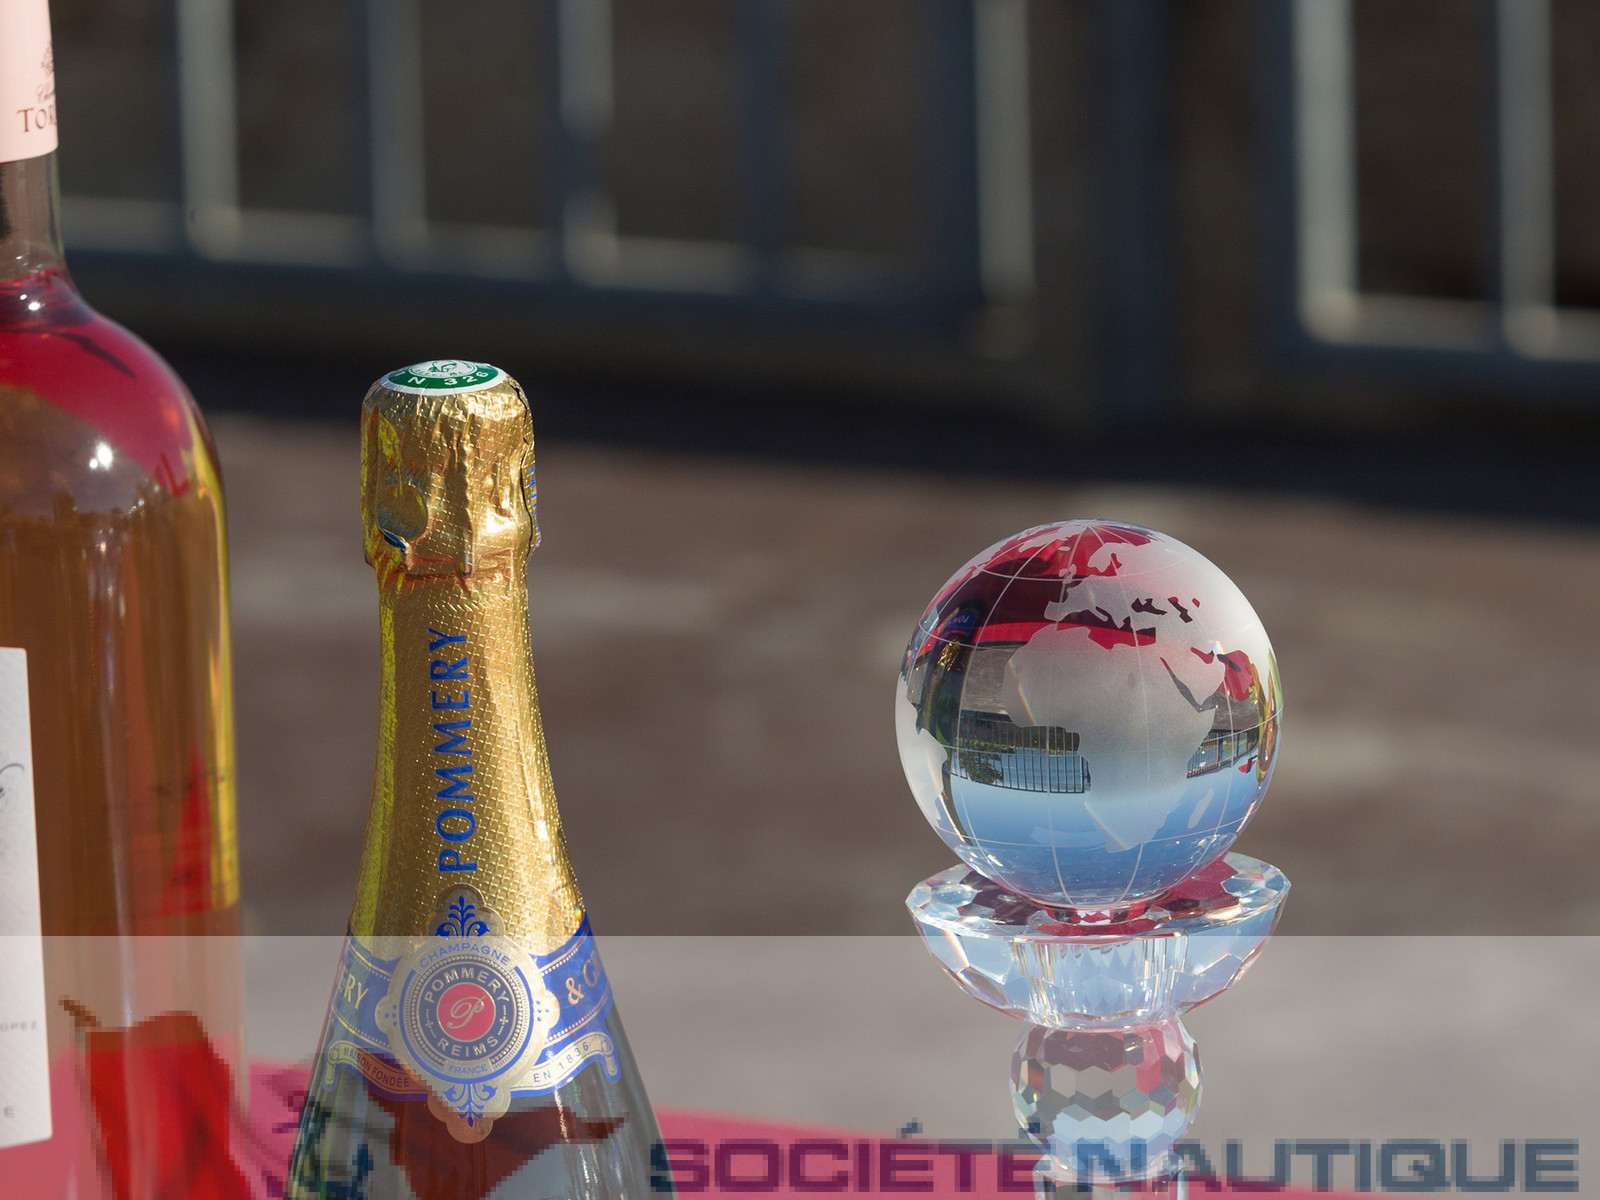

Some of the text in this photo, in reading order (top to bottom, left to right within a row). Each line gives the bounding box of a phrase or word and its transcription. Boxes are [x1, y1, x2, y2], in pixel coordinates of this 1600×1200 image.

[444, 371, 489, 386] 326
[427, 626, 478, 873] POMMERY
[419, 942, 511, 968] CHAMPAGNE
[424, 966, 510, 1003] POMMERY
[437, 1034, 499, 1057] REIMS
[448, 1064, 488, 1075] FRANCE
[533, 1070, 551, 1083] EN
[558, 1042, 589, 1070] 1836
